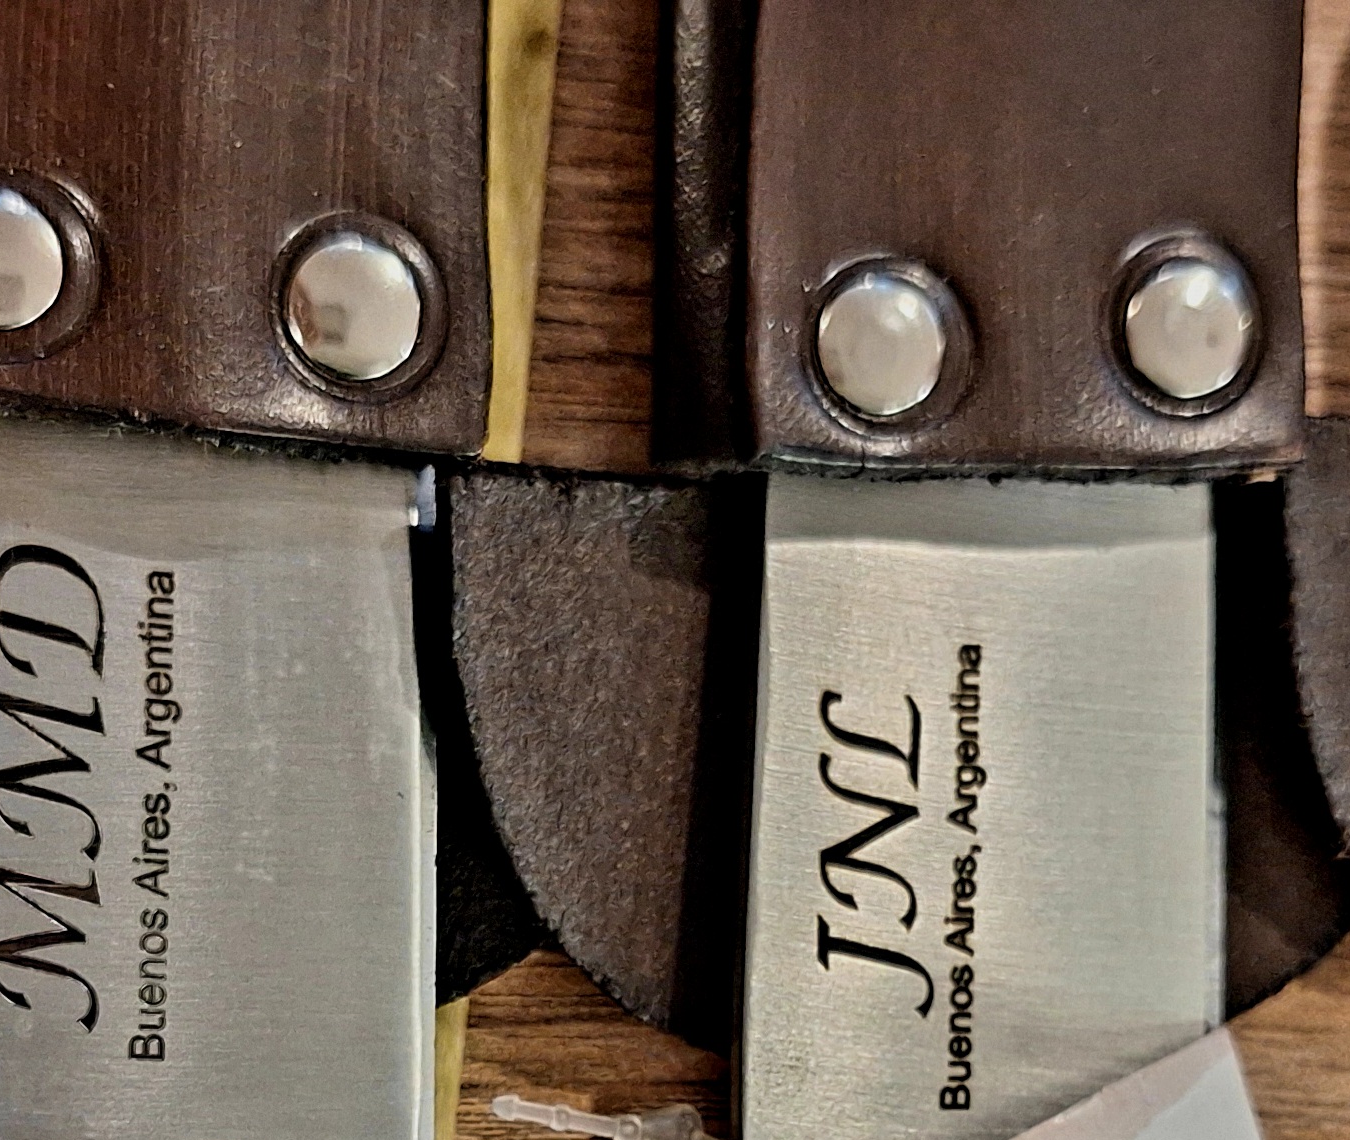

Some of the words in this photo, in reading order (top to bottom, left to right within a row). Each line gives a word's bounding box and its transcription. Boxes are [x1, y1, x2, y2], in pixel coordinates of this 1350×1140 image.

[136, 570, 183, 773] Argentina
[947, 644, 987, 834] Argentina
[132, 782, 178, 897] Aires,
[816, 690, 935, 1018] JNL
[944, 845, 982, 956] Aires,
[129, 908, 169, 1061] Buenos
[940, 964, 975, 1111] Buenos
